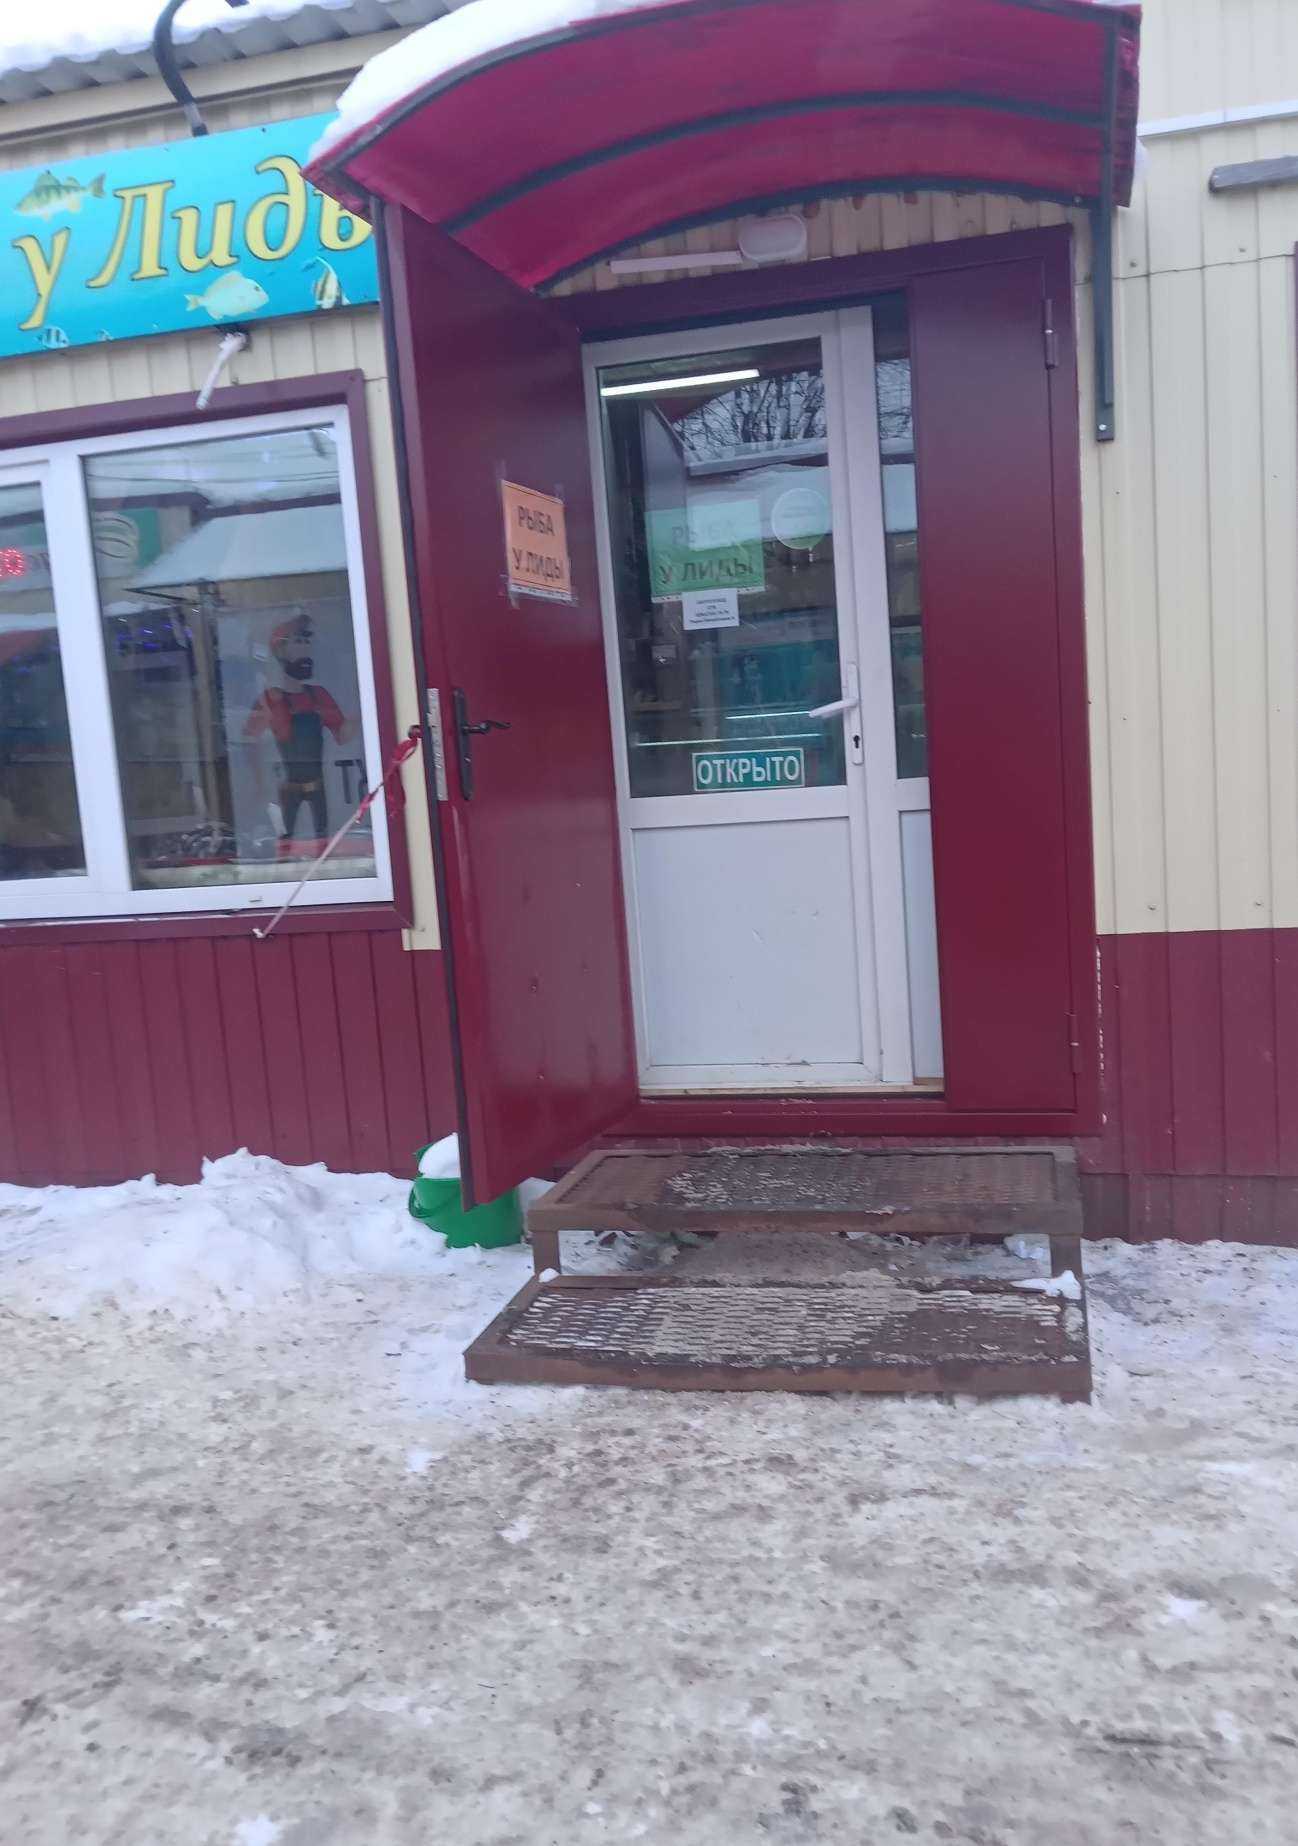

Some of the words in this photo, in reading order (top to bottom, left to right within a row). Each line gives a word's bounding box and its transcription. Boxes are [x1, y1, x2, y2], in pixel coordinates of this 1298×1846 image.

[517, 505, 556, 537] РЫБА
[526, 551, 565, 582] ЛИДЫ
[681, 556, 755, 583] ЛИДЫ
[697, 755, 800, 785] ОТКРЫТО
